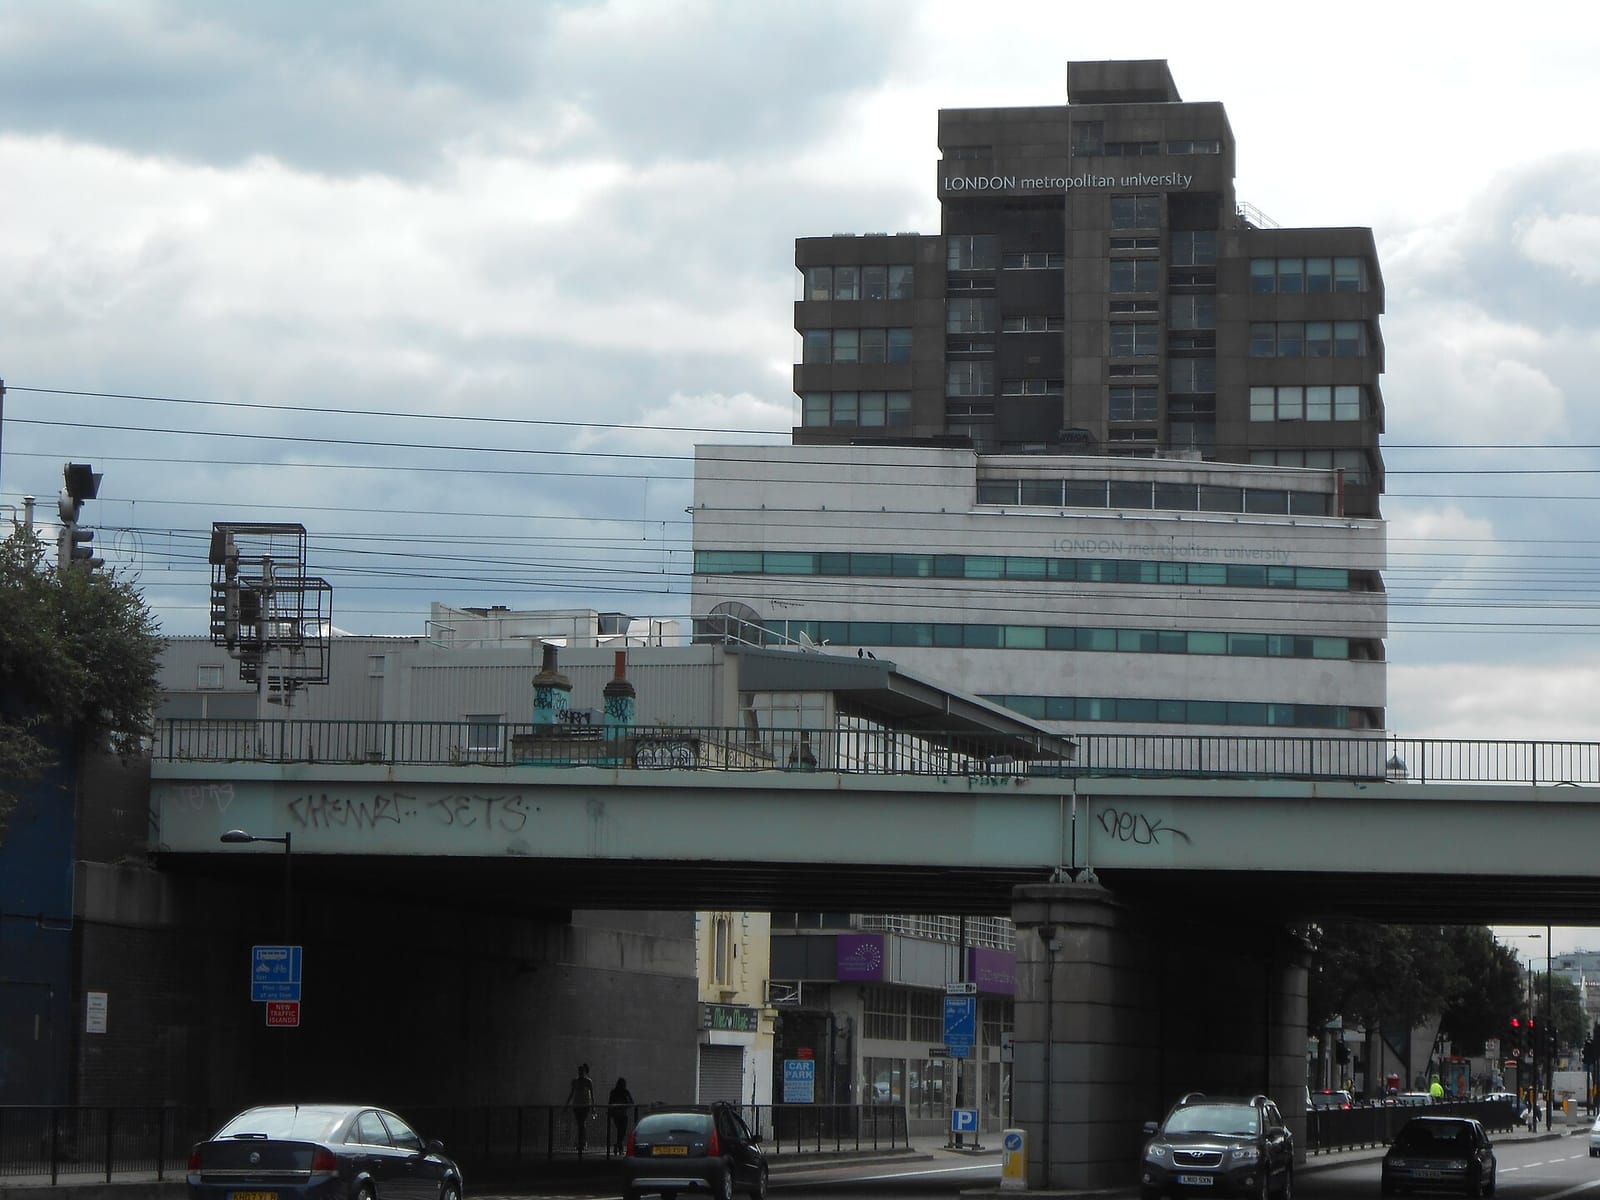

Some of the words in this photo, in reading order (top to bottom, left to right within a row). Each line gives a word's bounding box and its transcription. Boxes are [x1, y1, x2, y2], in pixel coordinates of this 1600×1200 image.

[944, 176, 1016, 191] LONDON
[1021, 173, 1115, 191] metropolitan
[1121, 171, 1192, 189] university
[1053, 539, 1123, 553] LONDON
[1128, 542, 1218, 560] metropolitan
[1223, 544, 1290, 563] university
[785, 1070, 812, 1079] PARK
[789, 1062, 809, 1070] CAR
[957, 1111, 973, 1130] P
